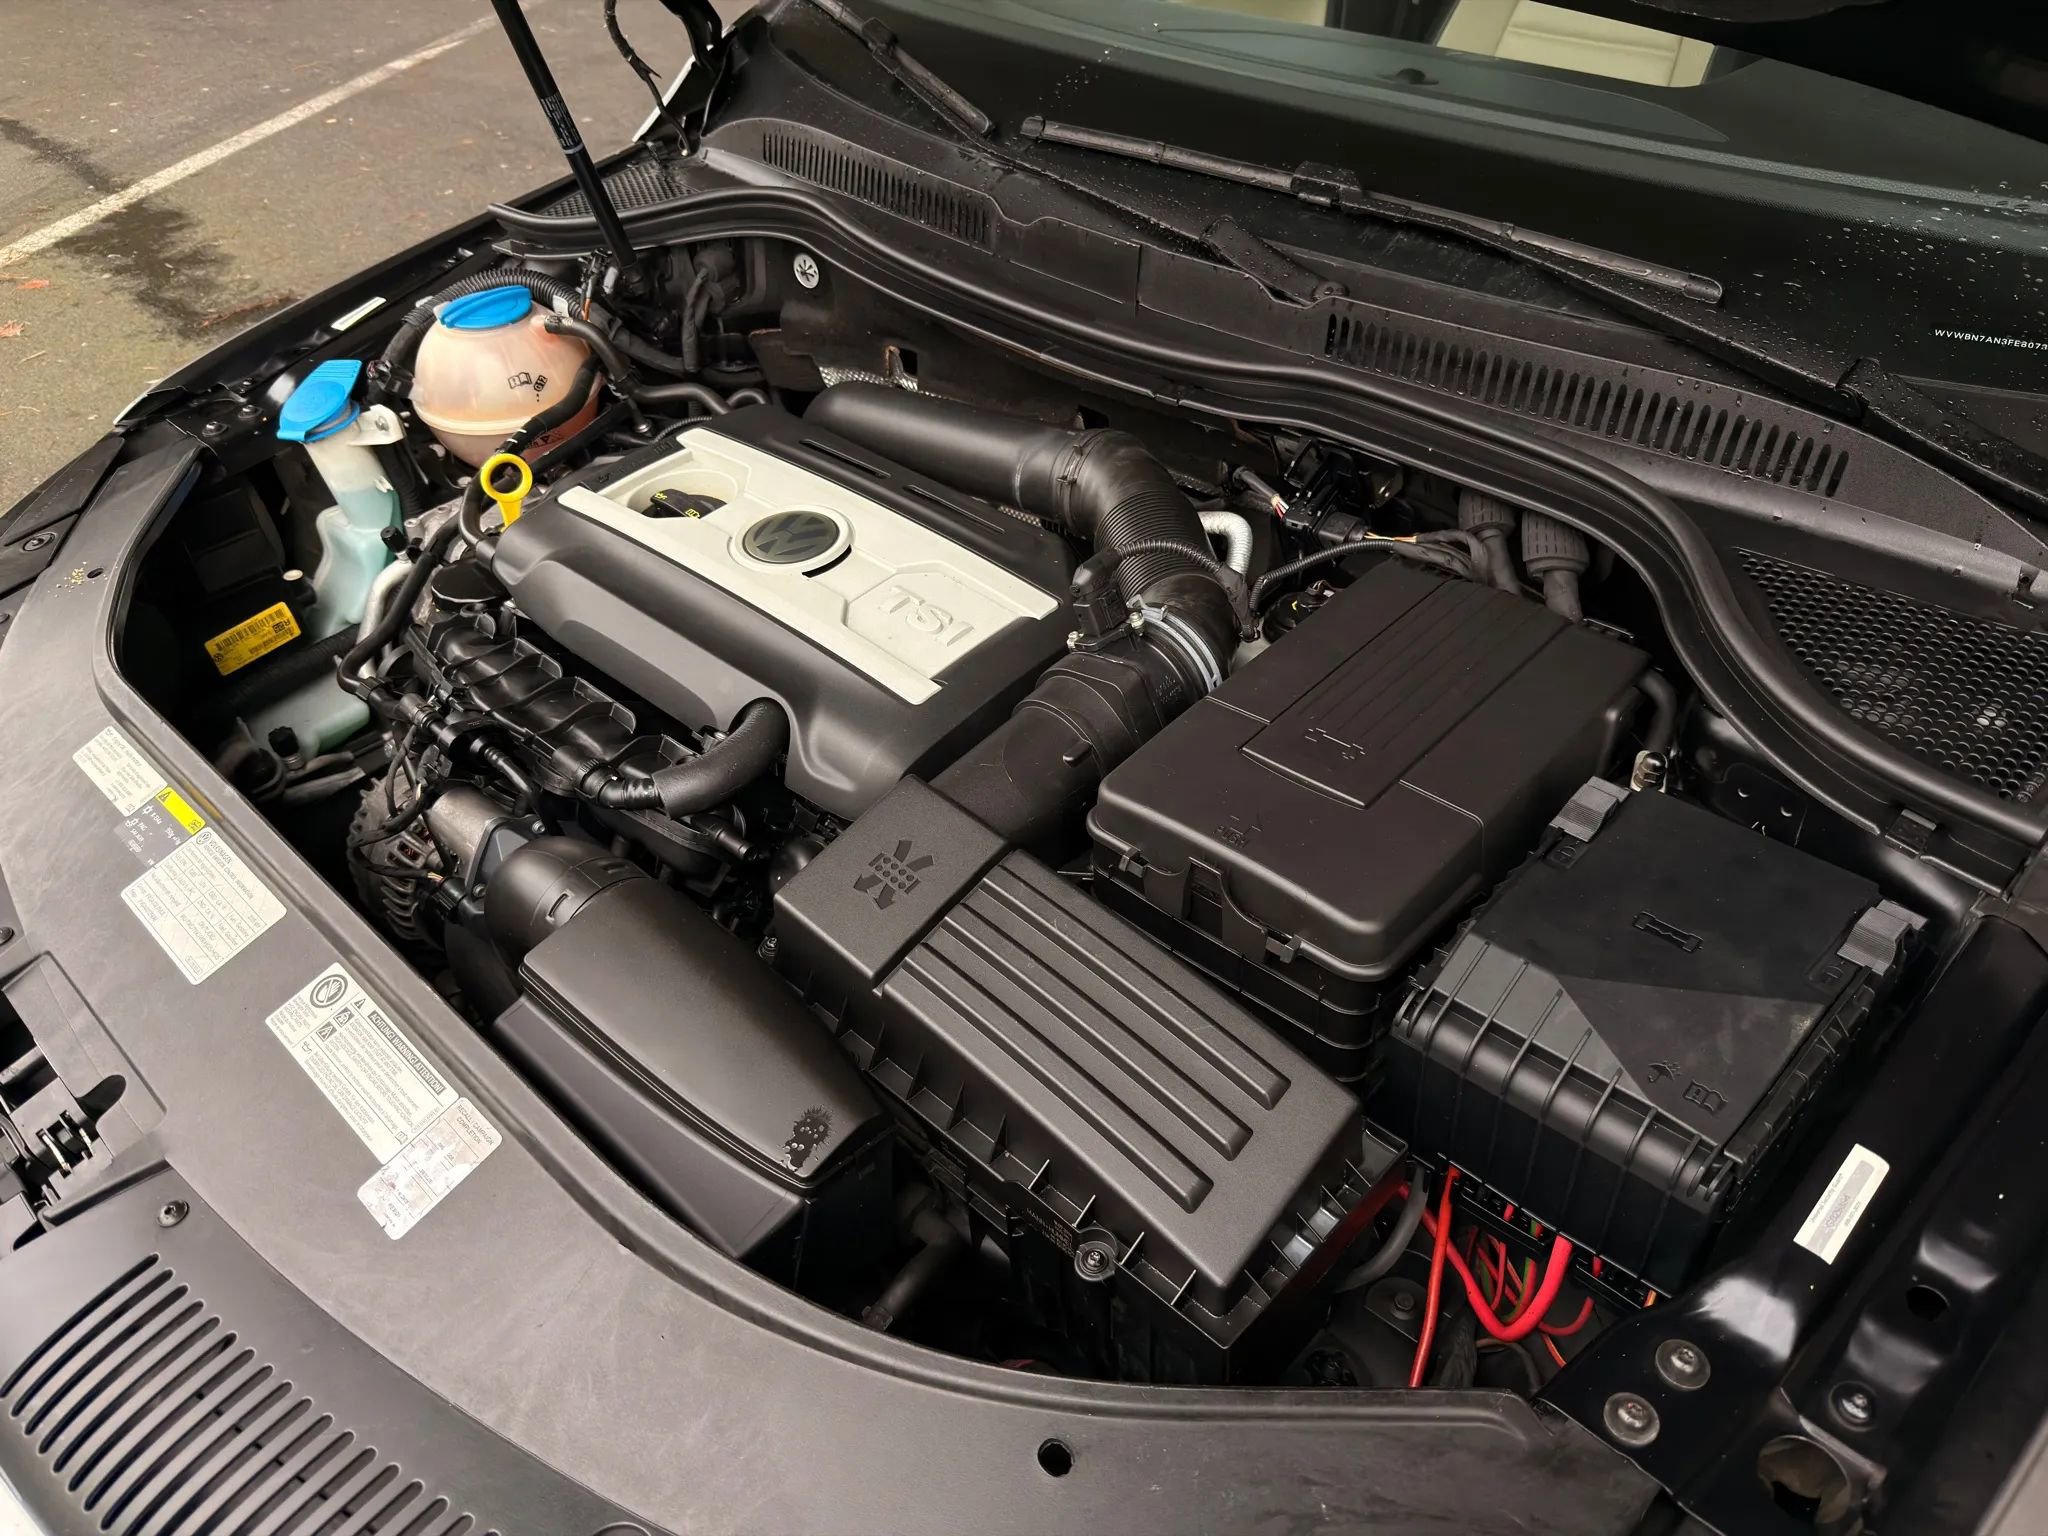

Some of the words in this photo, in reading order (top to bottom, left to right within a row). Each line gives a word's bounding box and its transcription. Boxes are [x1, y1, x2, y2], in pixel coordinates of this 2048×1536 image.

[878, 585, 975, 647] TSI
[207, 838, 232, 864] VOLKSWAGEN
[369, 1012, 397, 1041] ACHTUNG!
[391, 1036, 418, 1065] WARNING!
[412, 1060, 443, 1094] ATTENTION!
[455, 1104, 474, 1122] RECALL
[471, 1121, 495, 1145] CAMPAIGN
[455, 1115, 483, 1144] COMPLETION
